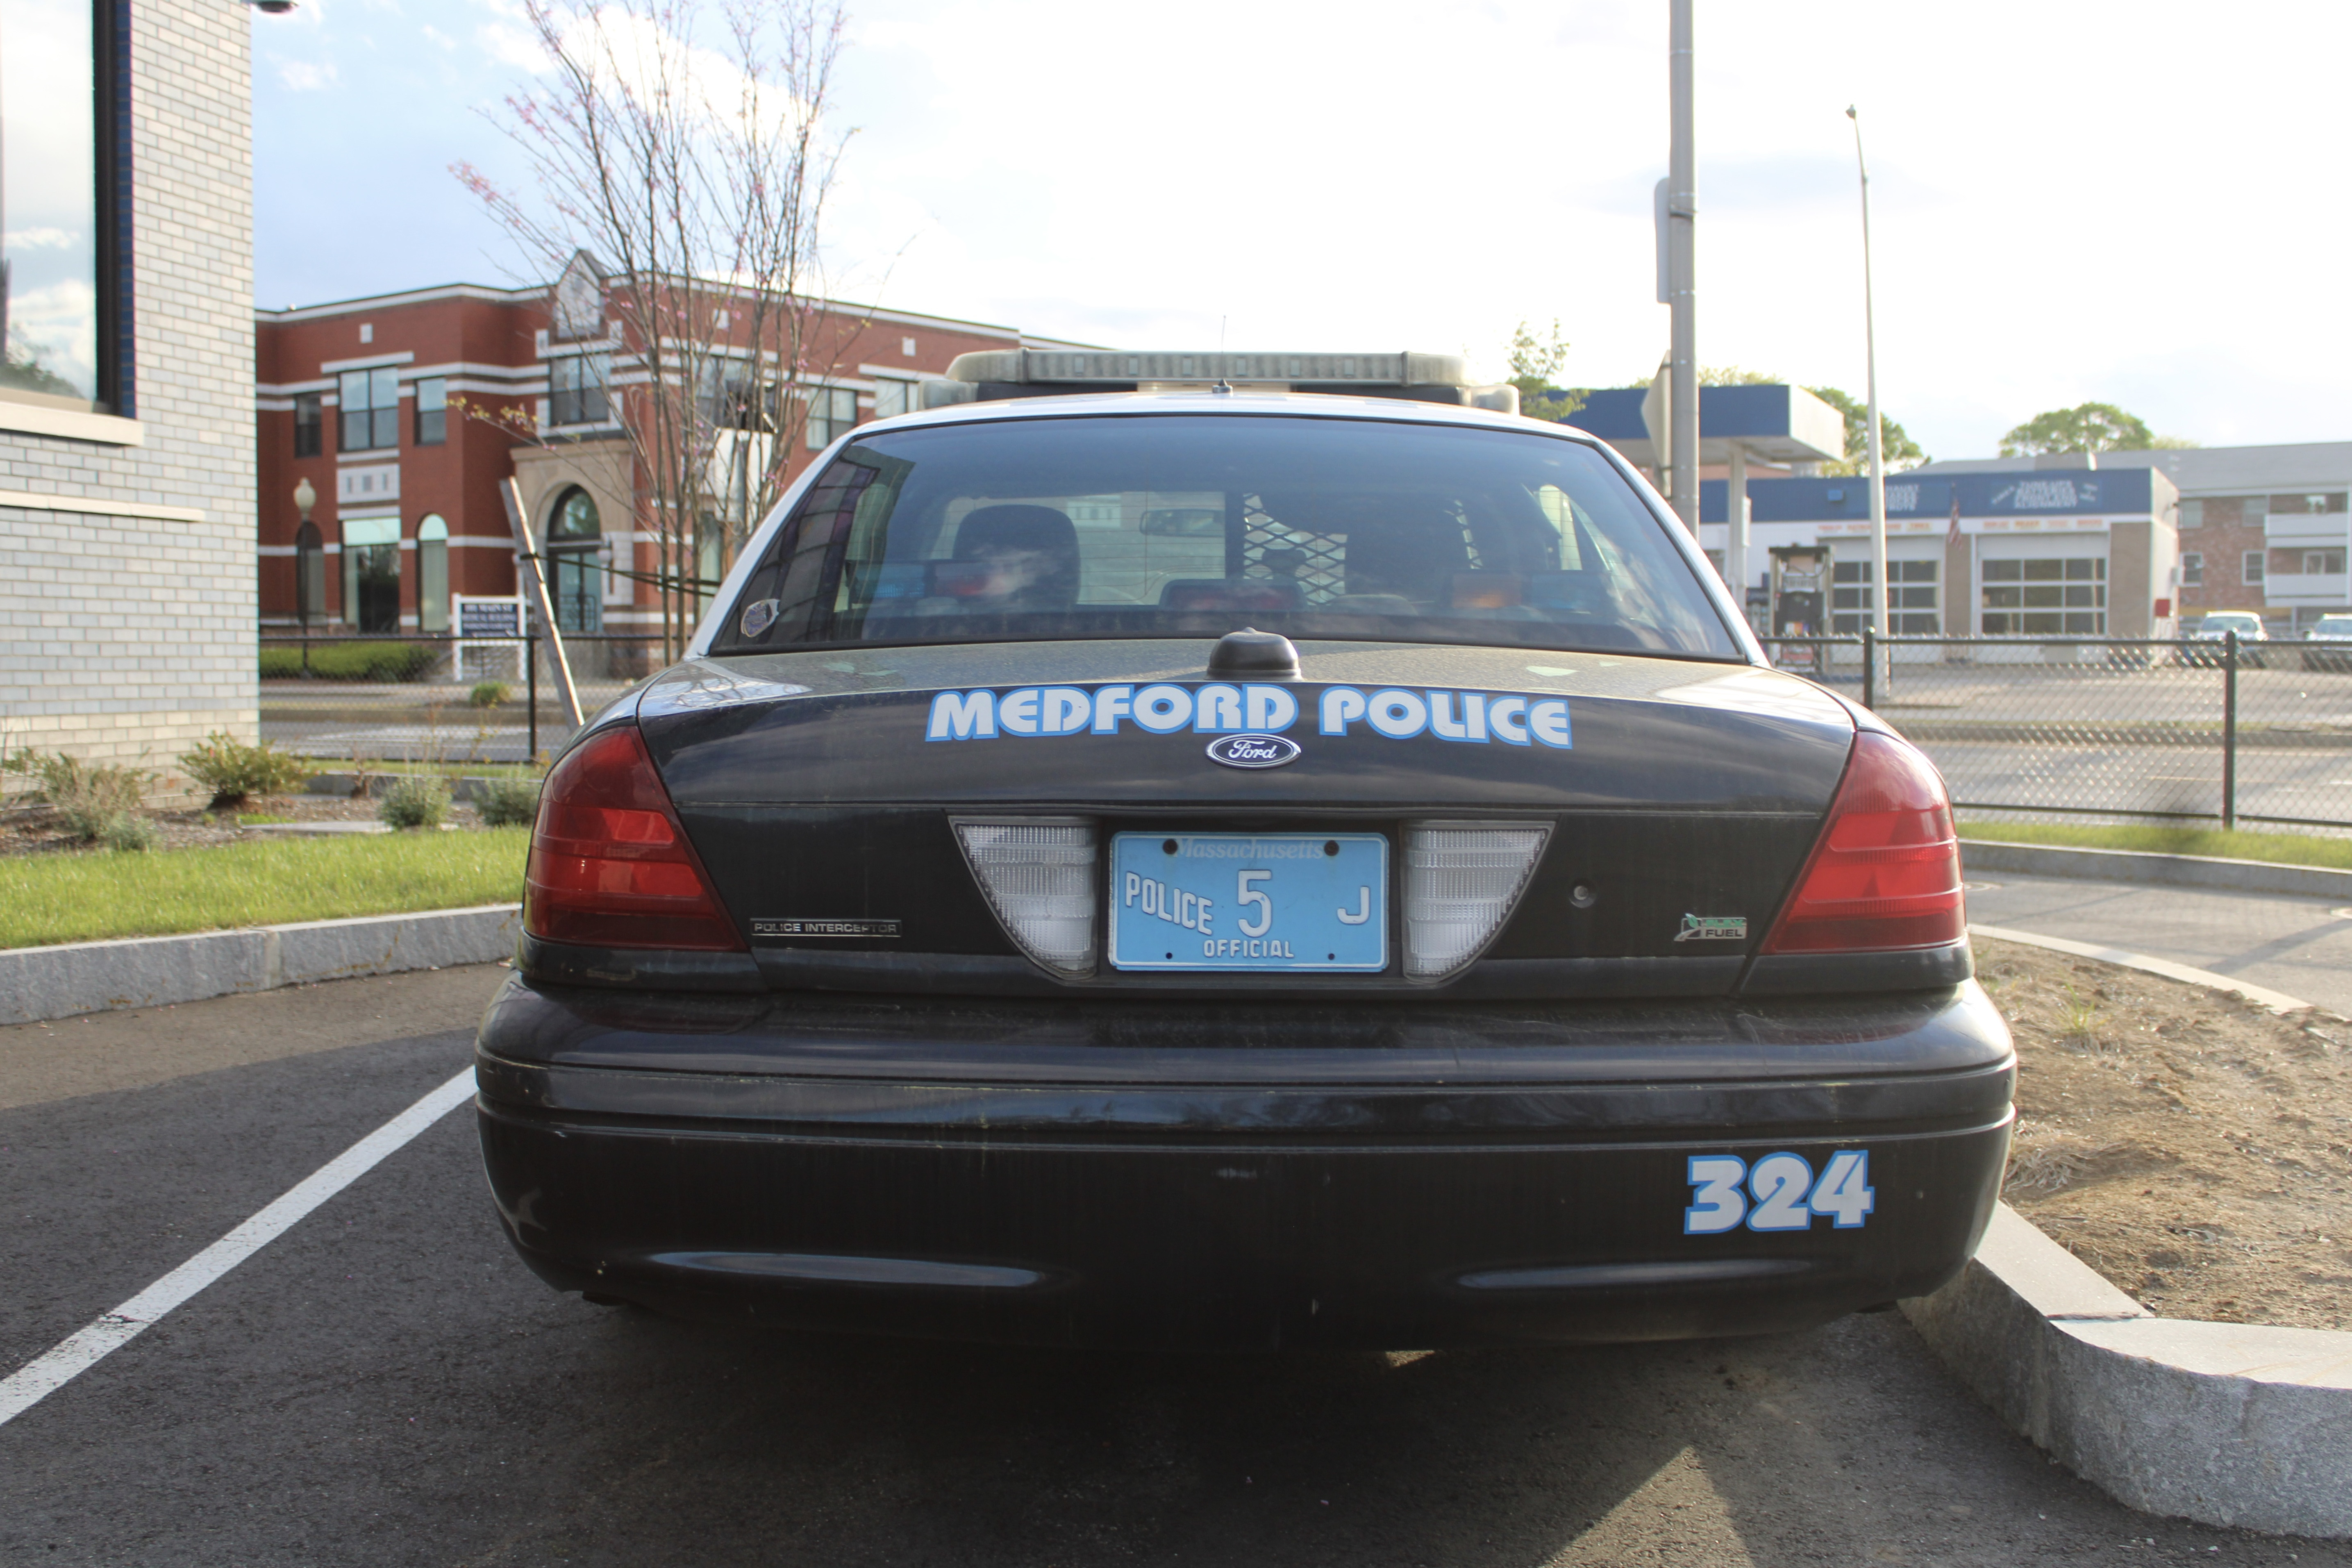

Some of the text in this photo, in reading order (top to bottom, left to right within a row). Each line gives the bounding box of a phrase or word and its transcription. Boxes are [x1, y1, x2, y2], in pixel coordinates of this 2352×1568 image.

[925, 682, 1572, 749] MEDFORD POLICE
[1228, 739, 1277, 759] Ford
[1174, 838, 1324, 859] Massachusetts
[1125, 870, 1370, 938] POLICE 5 J
[754, 923, 897, 933] POLICE INTERCEPTOR
[1705, 929, 1743, 937] FUEL
[1203, 939, 1295, 958] OFFICIAL
[1684, 1150, 1875, 1234] 324
